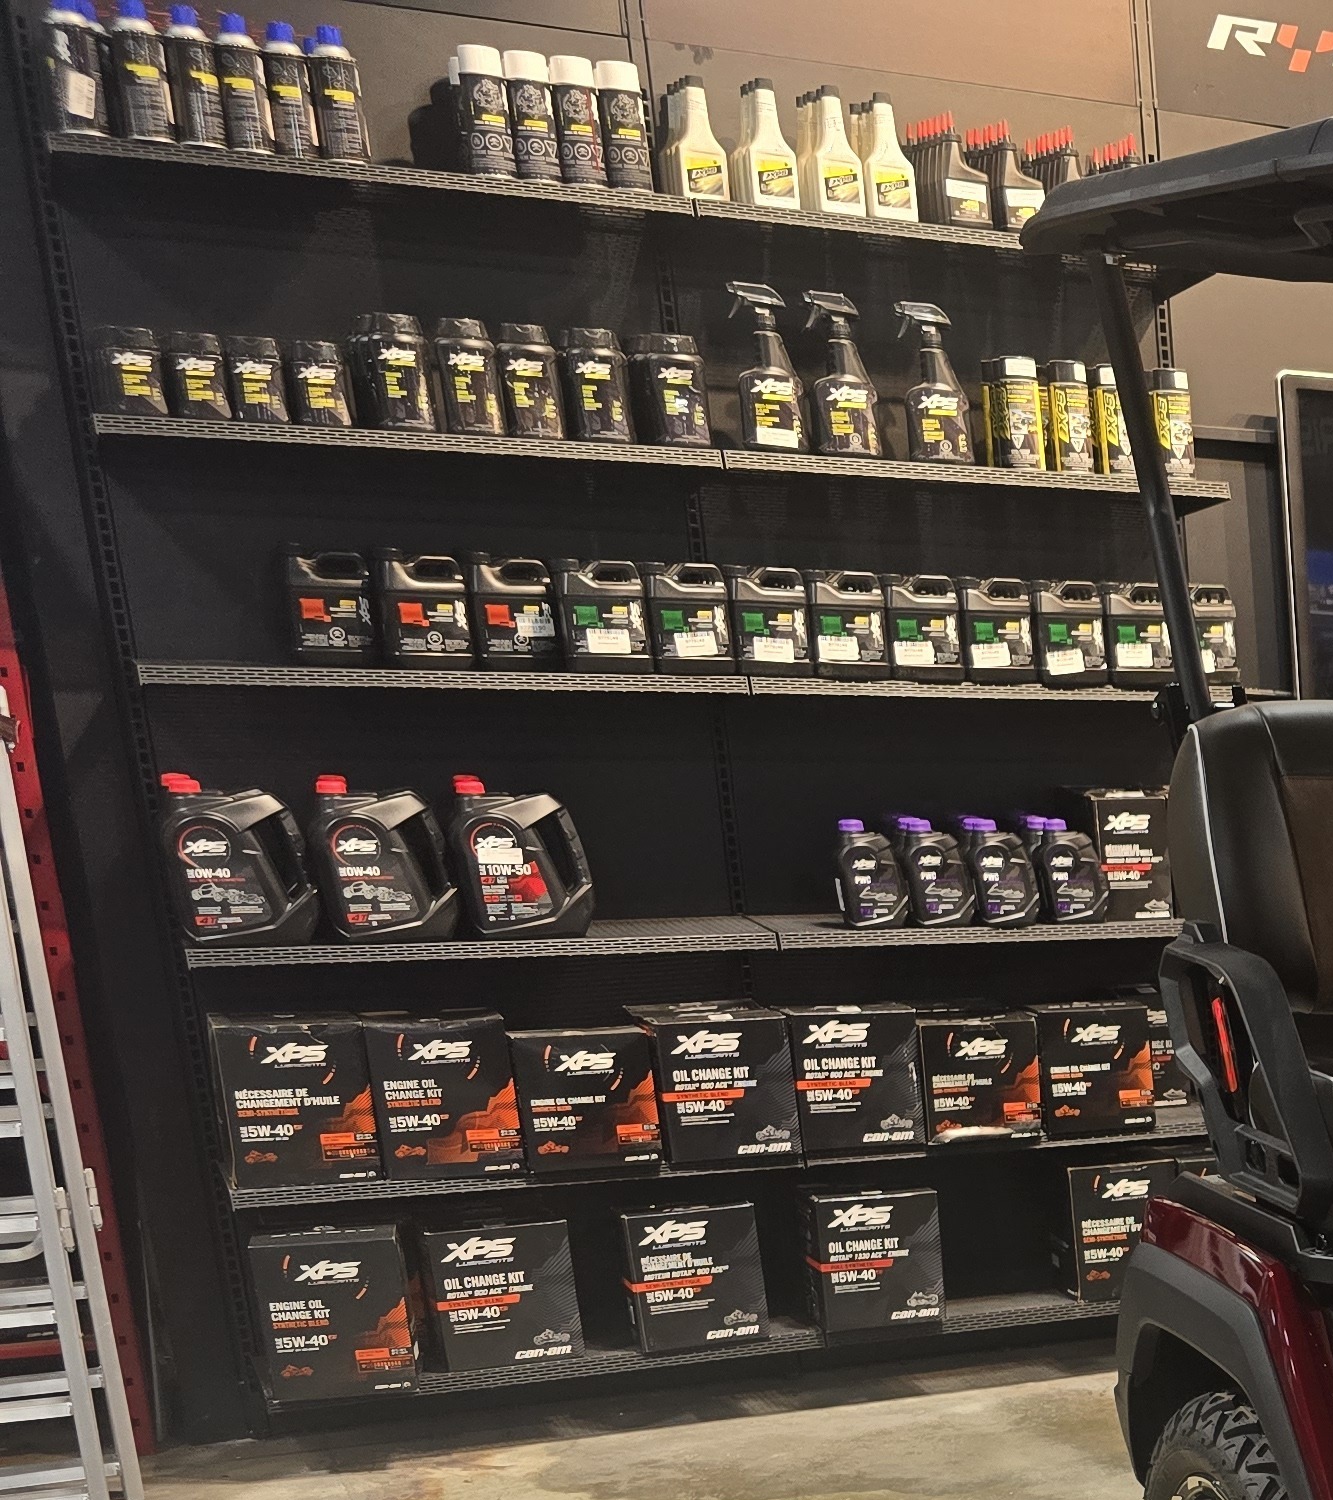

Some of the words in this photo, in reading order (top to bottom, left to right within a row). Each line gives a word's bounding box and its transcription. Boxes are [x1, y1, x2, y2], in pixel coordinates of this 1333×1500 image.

[112, 353, 152, 366] XPS
[379, 347, 416, 362] XPS
[448, 352, 485, 367] XPS
[176, 357, 216, 370] XPS
[234, 361, 273, 374] XPS
[506, 358, 543, 372] XPS
[576, 361, 612, 375] XPS
[298, 366, 337, 379] XPS
[658, 367, 694, 380] XPS
[751, 378, 794, 395] XPS
[826, 386, 868, 402] XPS
[918, 394, 959, 410] XPS
[1055, 390, 1067, 430] XPS
[1104, 392, 1116, 432] XPS
[1157, 397, 1169, 437] XPS
[359, 596, 372, 626] XPS
[454, 600, 469, 631] XPS
[1104, 812, 1151, 831] XPS
[183, 839, 229, 853] XPS
[335, 838, 379, 852] XPS
[488, 863, 532, 876] 10W-50
[802, 1020, 871, 1044] XPS
[1070, 1023, 1121, 1043] XPS
[407, 1039, 473, 1060] XPS
[670, 1030, 743, 1054] XPS
[954, 1037, 1009, 1057] XPS
[261, 1043, 329, 1064] XPS
[554, 1050, 617, 1072] XPS
[803, 1058, 820, 1071] OIL
[821, 1056, 860, 1070] CHANGE
[860, 1056, 877, 1068] KIT
[672, 1069, 691, 1082] OIL
[691, 1066, 733, 1081] CHANGE
[733, 1066, 750, 1079] KIT
[383, 1080, 420, 1091] ENGINE
[421, 1079, 438, 1089] OIL
[234, 1088, 294, 1100] NÉCESSAIRE
[295, 1087, 309, 1097] DE
[385, 1090, 425, 1101] CHANGE
[426, 1088, 443, 1098] KIT
[236, 1098, 302, 1109] CHANGEMENT
[685, 1099, 726, 1113] 5W-40
[396, 1113, 441, 1129] 5W-40
[247, 1123, 295, 1138] 5W-40
[862, 1131, 915, 1142] can-am
[737, 1141, 792, 1155] can-am
[1101, 1178, 1151, 1199] XPS
[827, 1204, 894, 1228] XPS
[639, 1220, 709, 1246] XPS
[441, 1236, 517, 1263] XPS
[828, 1241, 845, 1254] OIL
[845, 1238, 883, 1252] CHANGE
[883, 1237, 900, 1249] KIT
[294, 1260, 362, 1282] XPS
[443, 1278, 463, 1291] OIL
[463, 1273, 507, 1289] CHANGE
[507, 1270, 525, 1284] KIT
[654, 1287, 694, 1303] 5W-40
[269, 1302, 306, 1312] ENGINE
[307, 1299, 325, 1310] OIL
[457, 1305, 501, 1321] 5W-40
[890, 1307, 940, 1320] can-am
[270, 1310, 313, 1322] CHANGE
[313, 1308, 331, 1319] KIT
[706, 1325, 760, 1340] can-am
[282, 1334, 329, 1349] 5W-40
[514, 1344, 573, 1360] can-am
